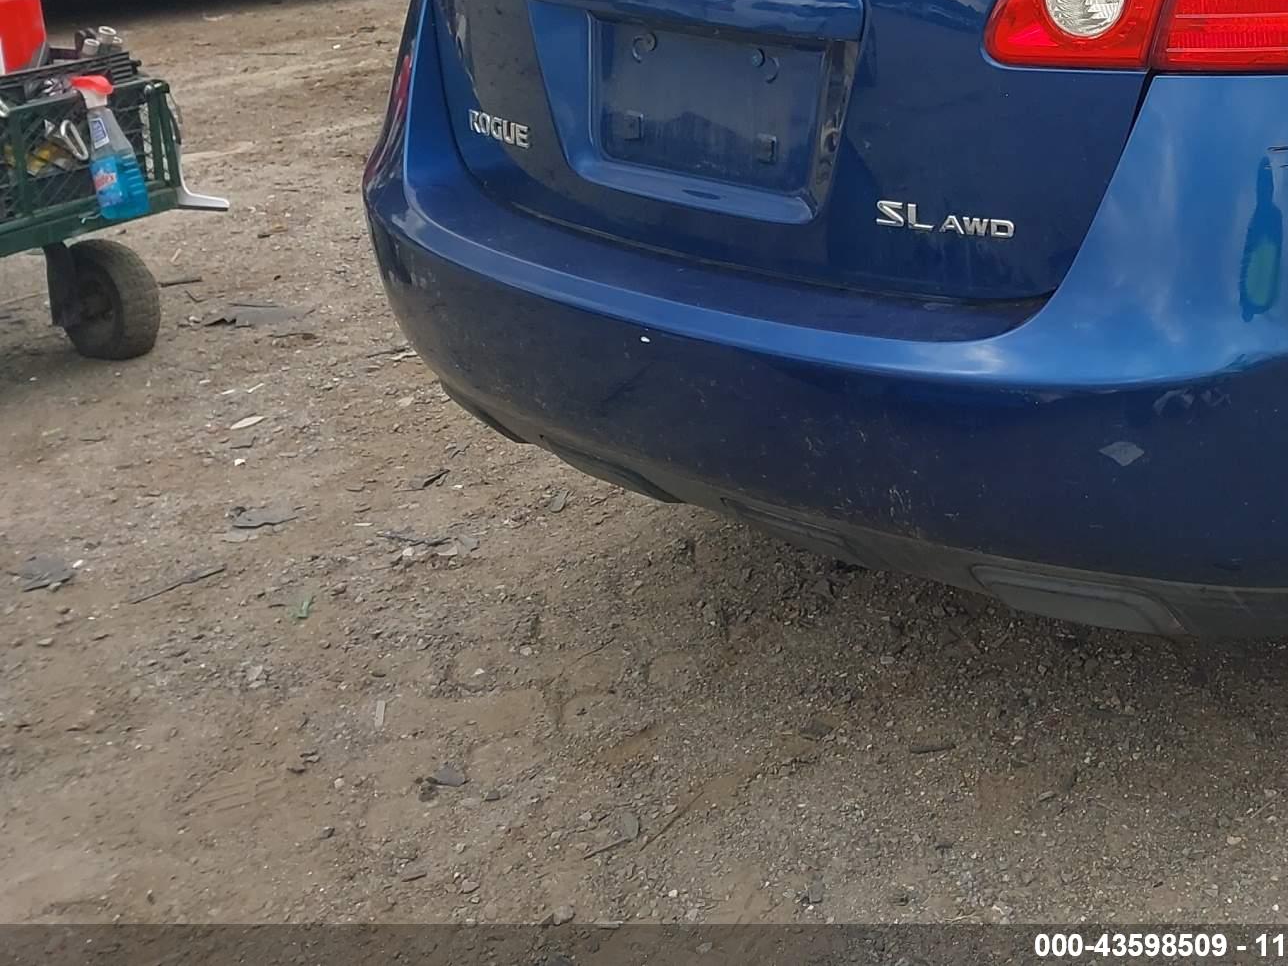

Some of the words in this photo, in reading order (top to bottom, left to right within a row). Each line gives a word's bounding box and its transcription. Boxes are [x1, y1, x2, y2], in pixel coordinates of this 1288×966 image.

[468, 109, 529, 149] ROGUE
[876, 200, 934, 231] SL
[939, 215, 1015, 238] AWD
